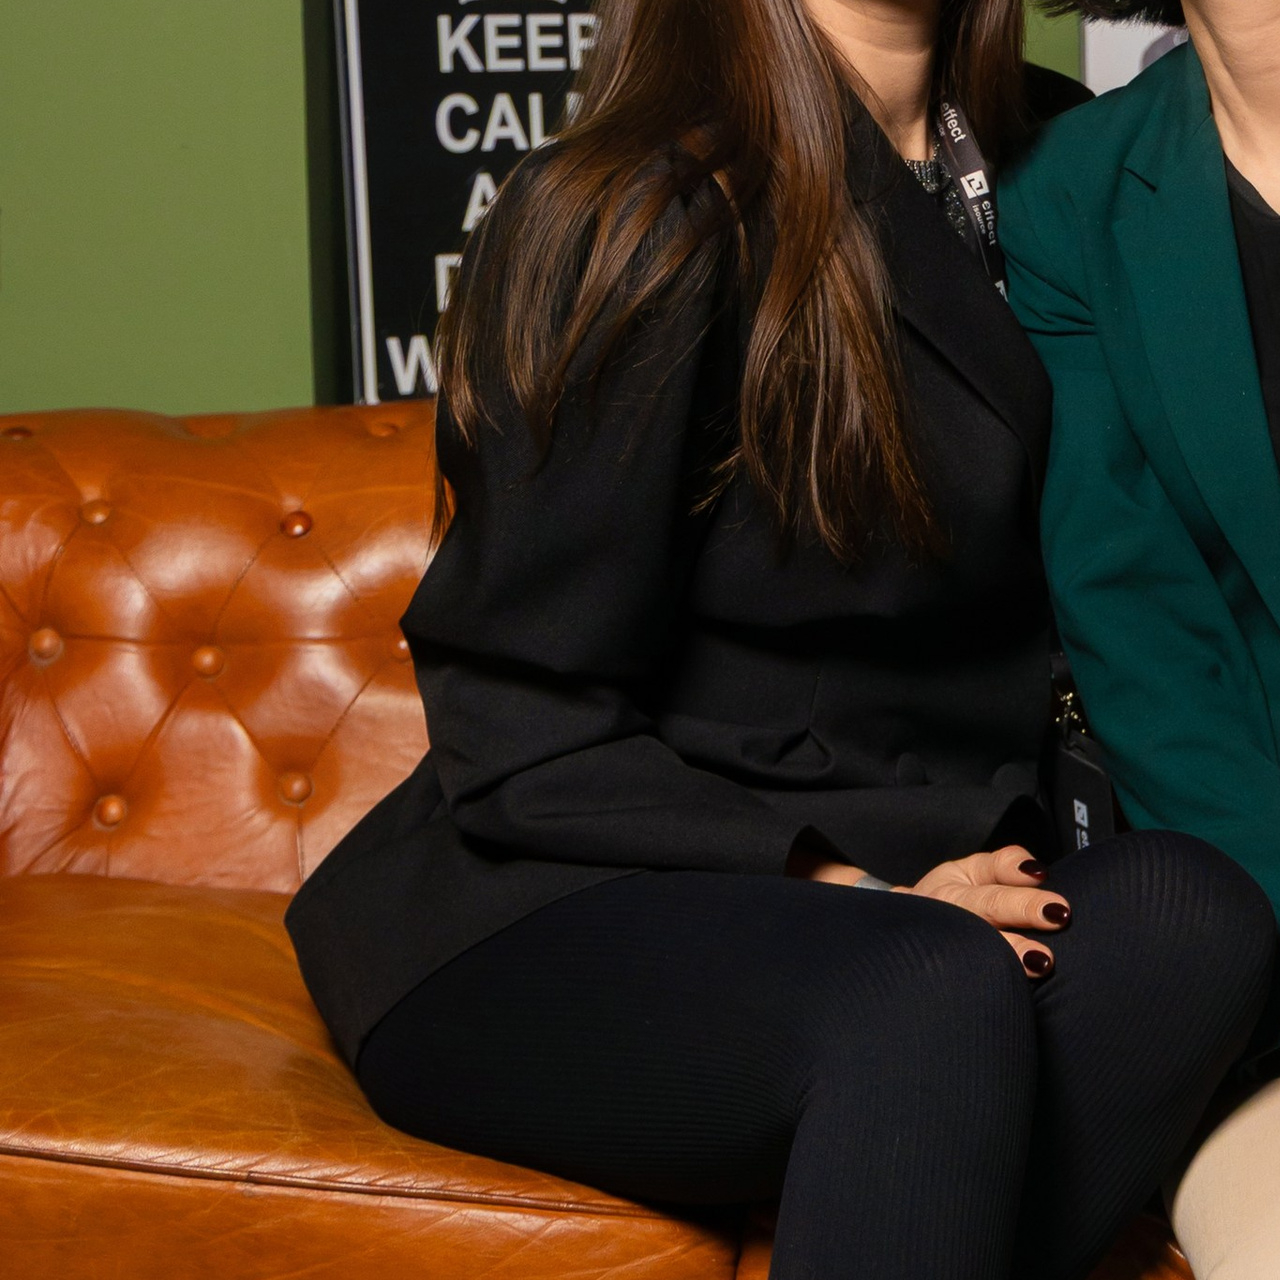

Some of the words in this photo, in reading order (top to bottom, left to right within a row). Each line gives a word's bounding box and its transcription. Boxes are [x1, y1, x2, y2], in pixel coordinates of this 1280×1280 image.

[437, 13, 601, 73] KEEP
[942, 102, 967, 143] effect
[981, 200, 997, 245] effect
